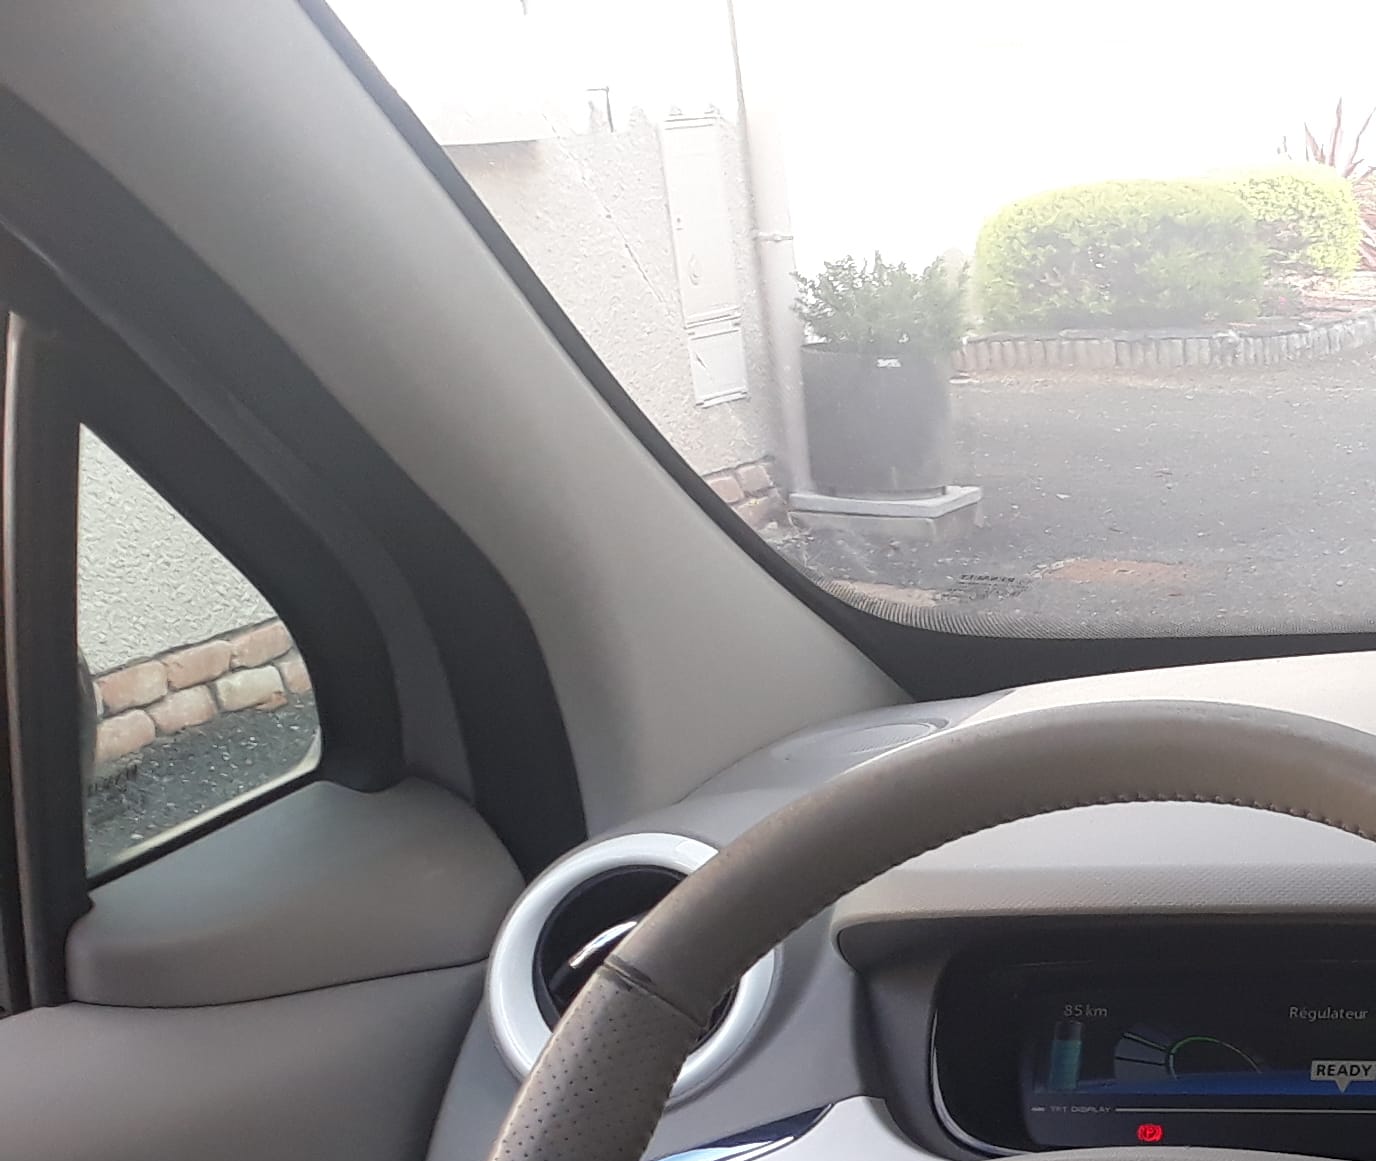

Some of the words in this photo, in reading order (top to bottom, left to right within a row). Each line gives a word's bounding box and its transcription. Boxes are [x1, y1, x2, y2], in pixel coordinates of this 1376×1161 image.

[1085, 1004, 1108, 1017] km
[1289, 1006, 1369, 1022] Régulateur
[1315, 1063, 1373, 1077] READY
